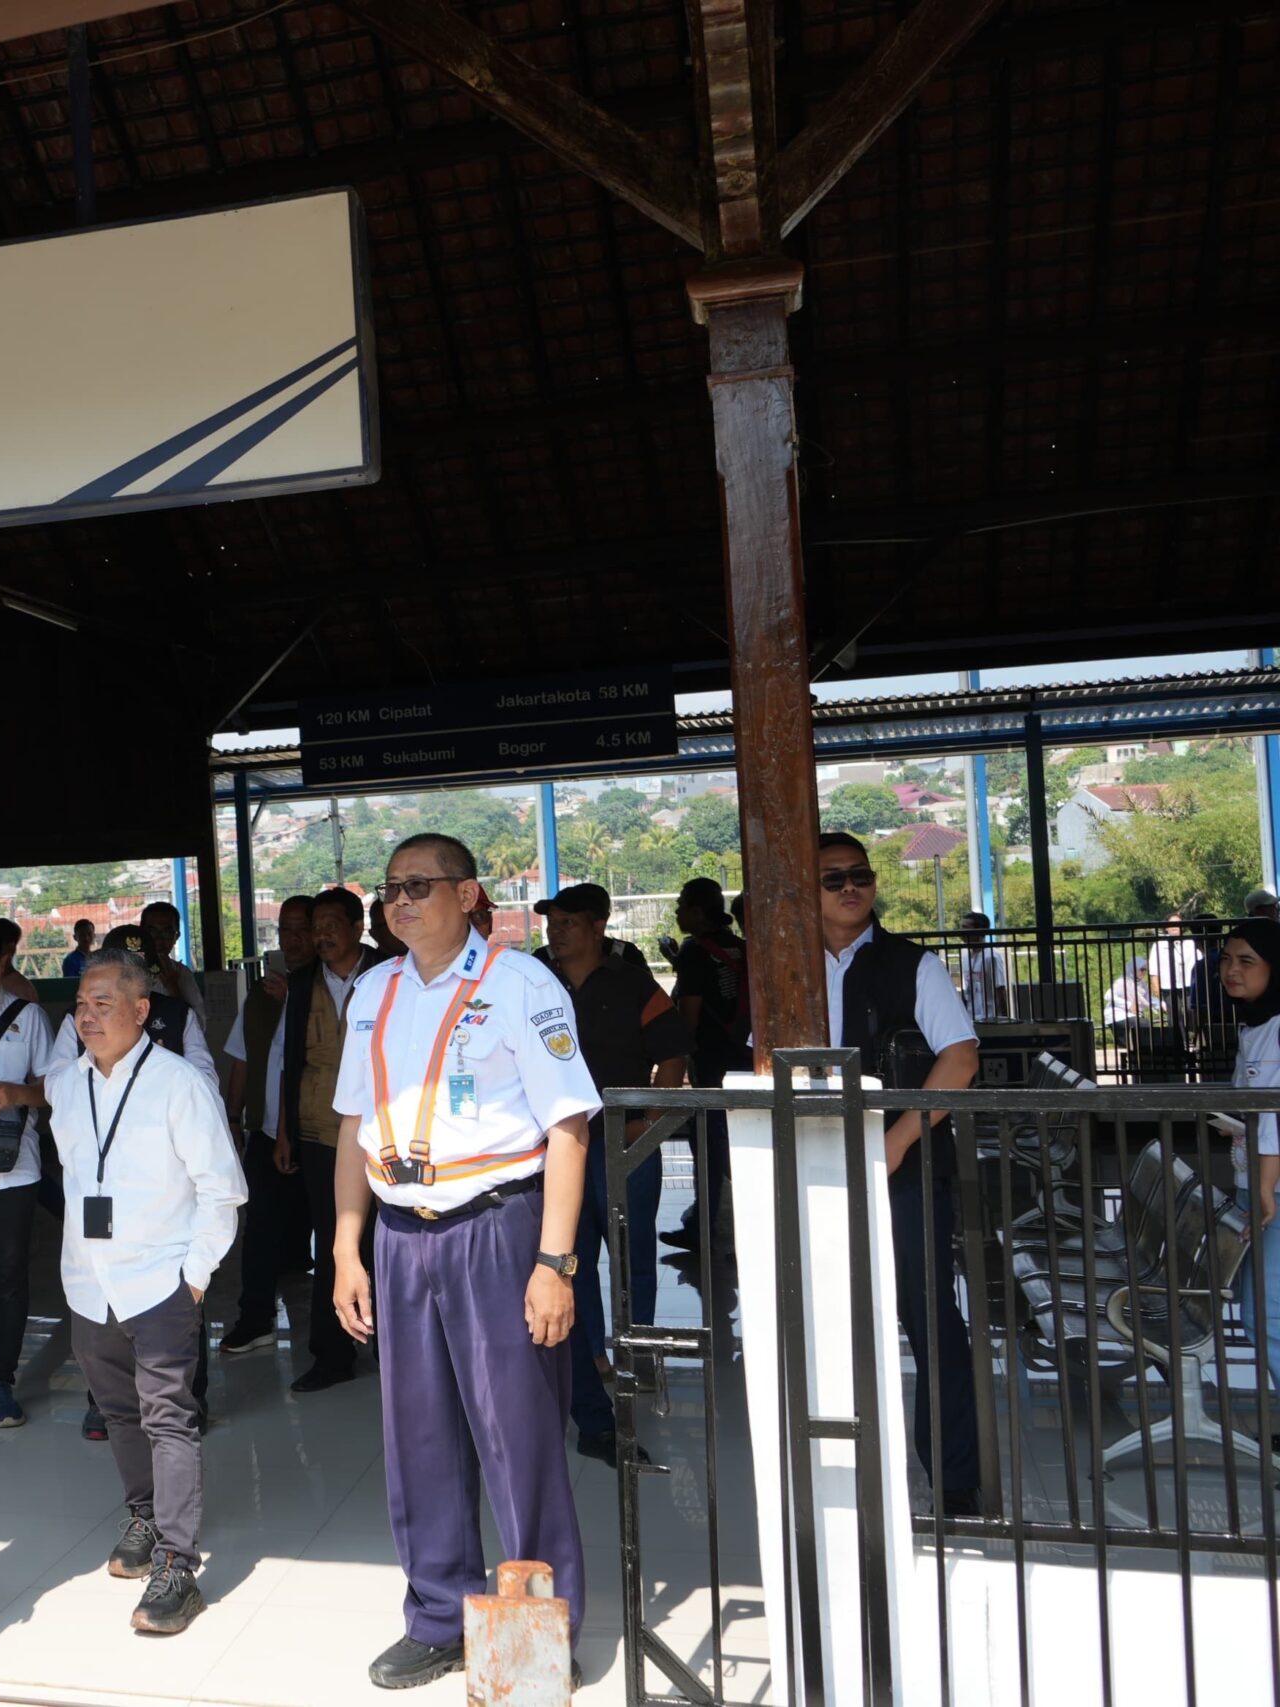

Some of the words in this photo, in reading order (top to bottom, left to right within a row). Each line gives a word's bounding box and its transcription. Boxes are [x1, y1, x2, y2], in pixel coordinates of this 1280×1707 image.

[495, 688, 592, 709] Jakartakota
[598, 685, 619, 700] 58
[622, 682, 649, 698] KM
[316, 711, 344, 726] 120
[346, 709, 370, 724] KM
[378, 703, 433, 722] Cipatat
[498, 741, 547, 757] Bogor
[595, 733, 621, 749] 4.5
[625, 730, 652, 746] KM
[318, 756, 338, 771] 53
[340, 753, 365, 769] KM
[382, 745, 456, 766] Sukabumi
[460, 1013, 489, 1026] KAI
[534, 1011, 553, 1023] DAOP
